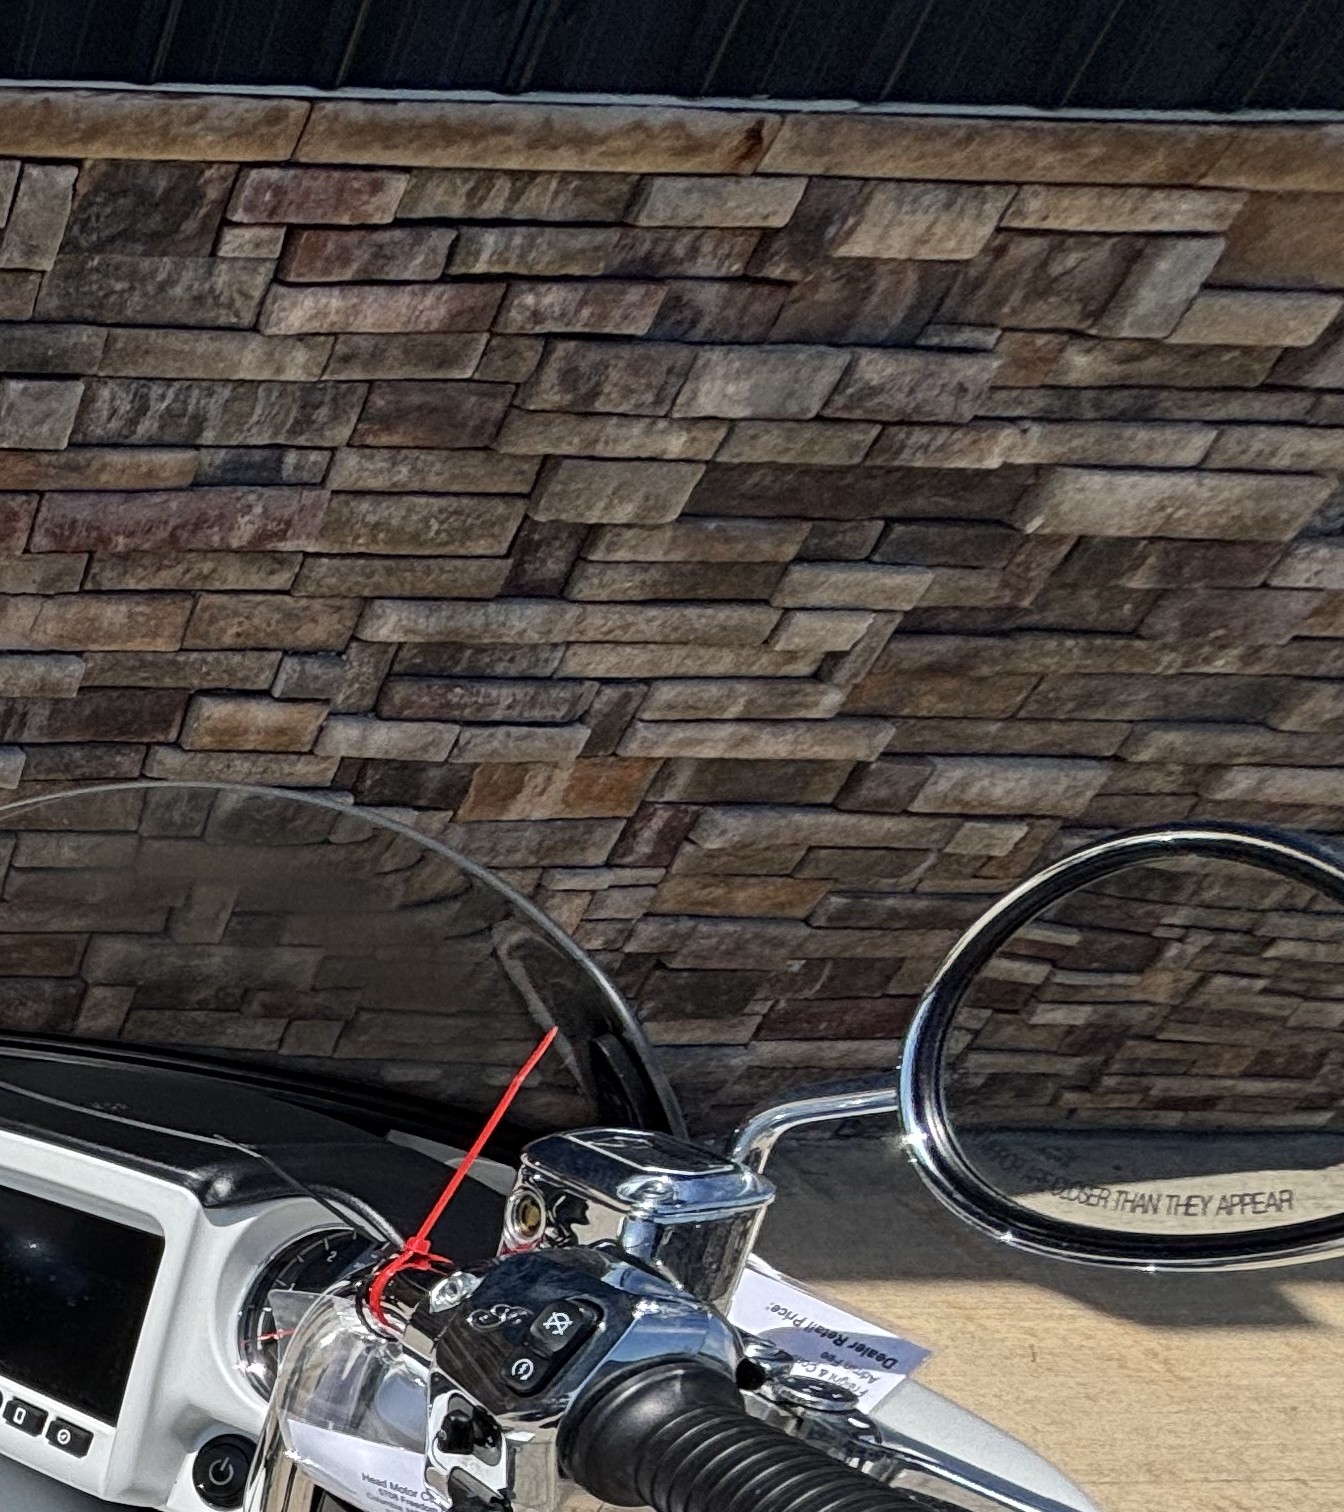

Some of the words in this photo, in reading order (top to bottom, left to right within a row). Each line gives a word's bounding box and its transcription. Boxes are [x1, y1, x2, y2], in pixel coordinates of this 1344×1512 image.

[1111, 1188, 1162, 1214] THAN
[1164, 1193, 1215, 1217] THEY
[1215, 1188, 1295, 1217] APPEAR
[765, 1302, 809, 1328] Price:
[803, 1321, 850, 1347] Retail
[846, 1341, 899, 1370] Dealer
